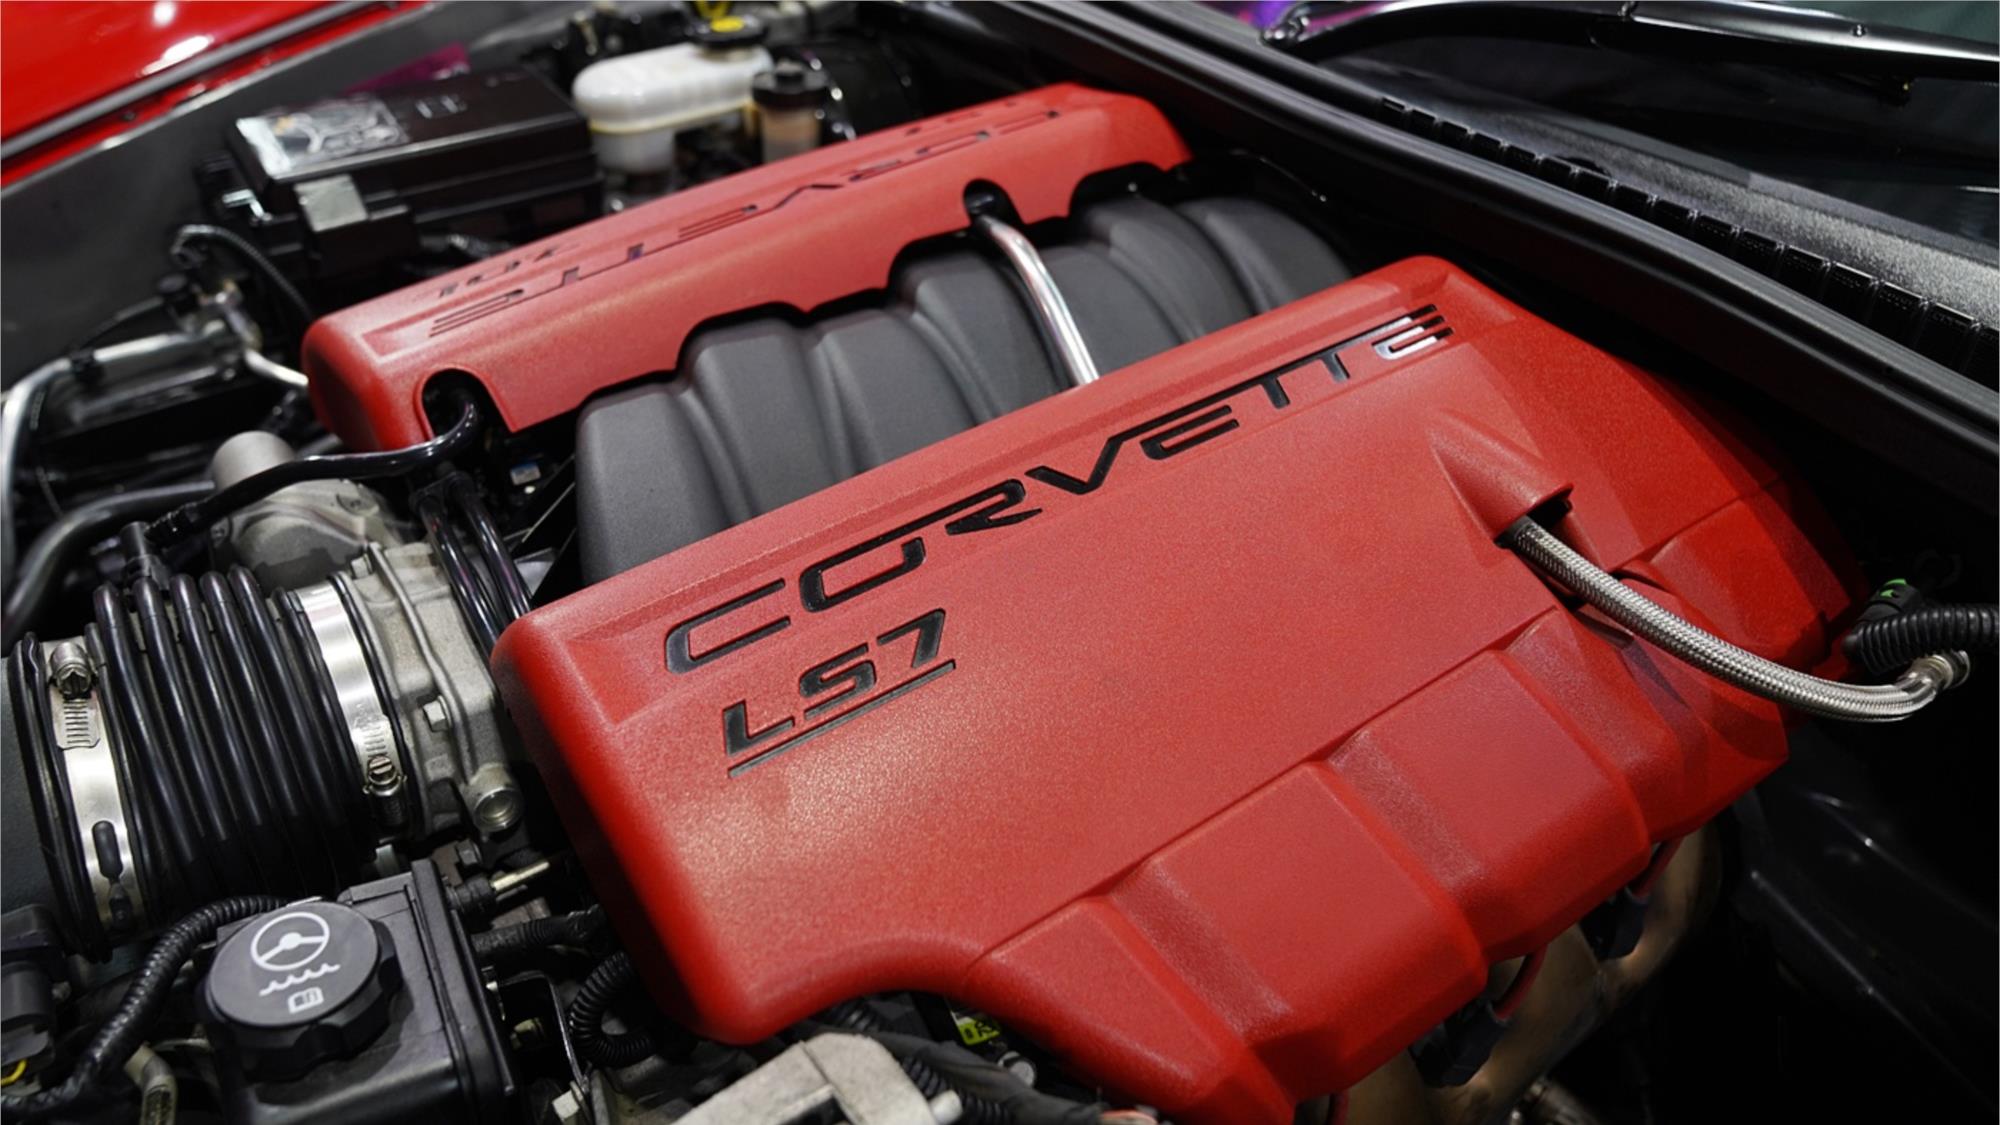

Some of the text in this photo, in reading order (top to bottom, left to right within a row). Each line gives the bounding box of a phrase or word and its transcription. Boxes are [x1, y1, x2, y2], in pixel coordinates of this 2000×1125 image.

[429, 110, 1060, 337] CORVETTE
[664, 304, 1454, 675] CORVETTE
[722, 608, 946, 757] LS7
